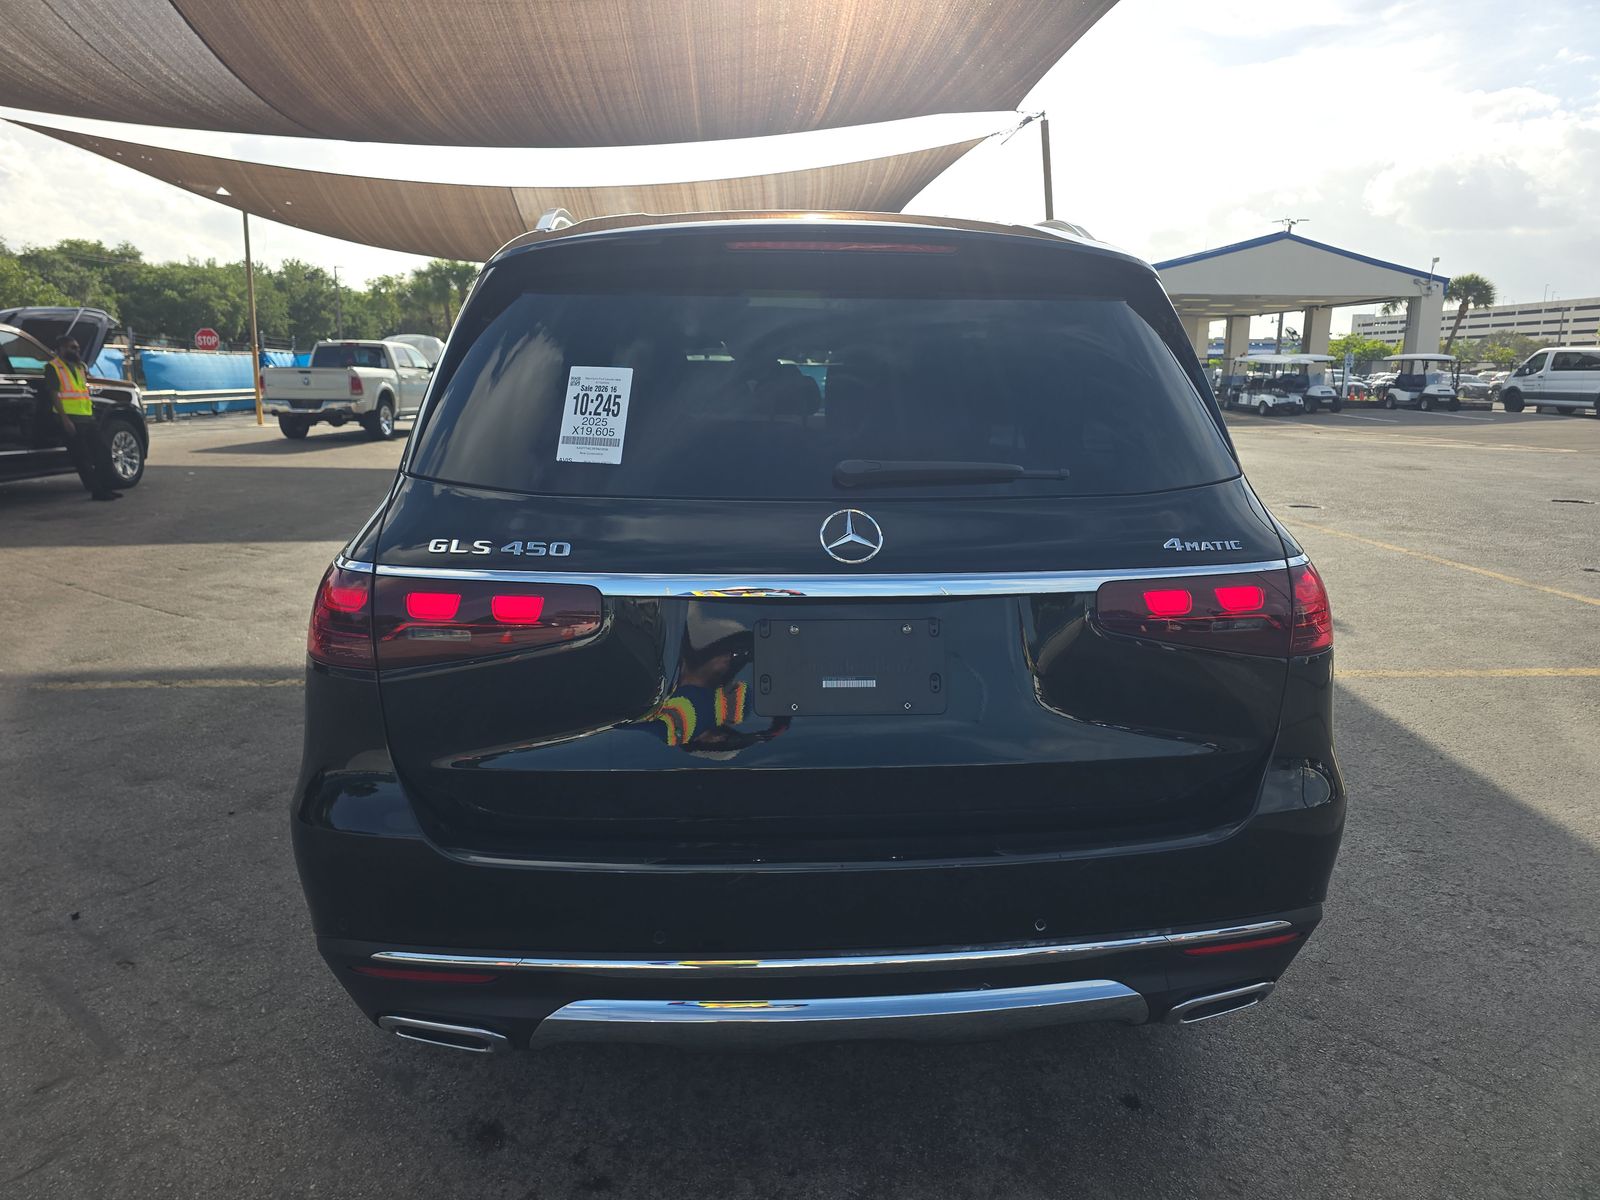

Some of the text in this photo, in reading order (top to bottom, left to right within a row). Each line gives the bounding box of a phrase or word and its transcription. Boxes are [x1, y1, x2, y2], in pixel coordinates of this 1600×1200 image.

[197, 335, 217, 346] STOP
[580, 385, 593, 393] Sale
[610, 386, 618, 394] 16
[573, 393, 621, 417] 10:245
[581, 417, 608, 427] 2025
[428, 539, 571, 557] GLS 450
[1163, 537, 1243, 551] 4MATIC
